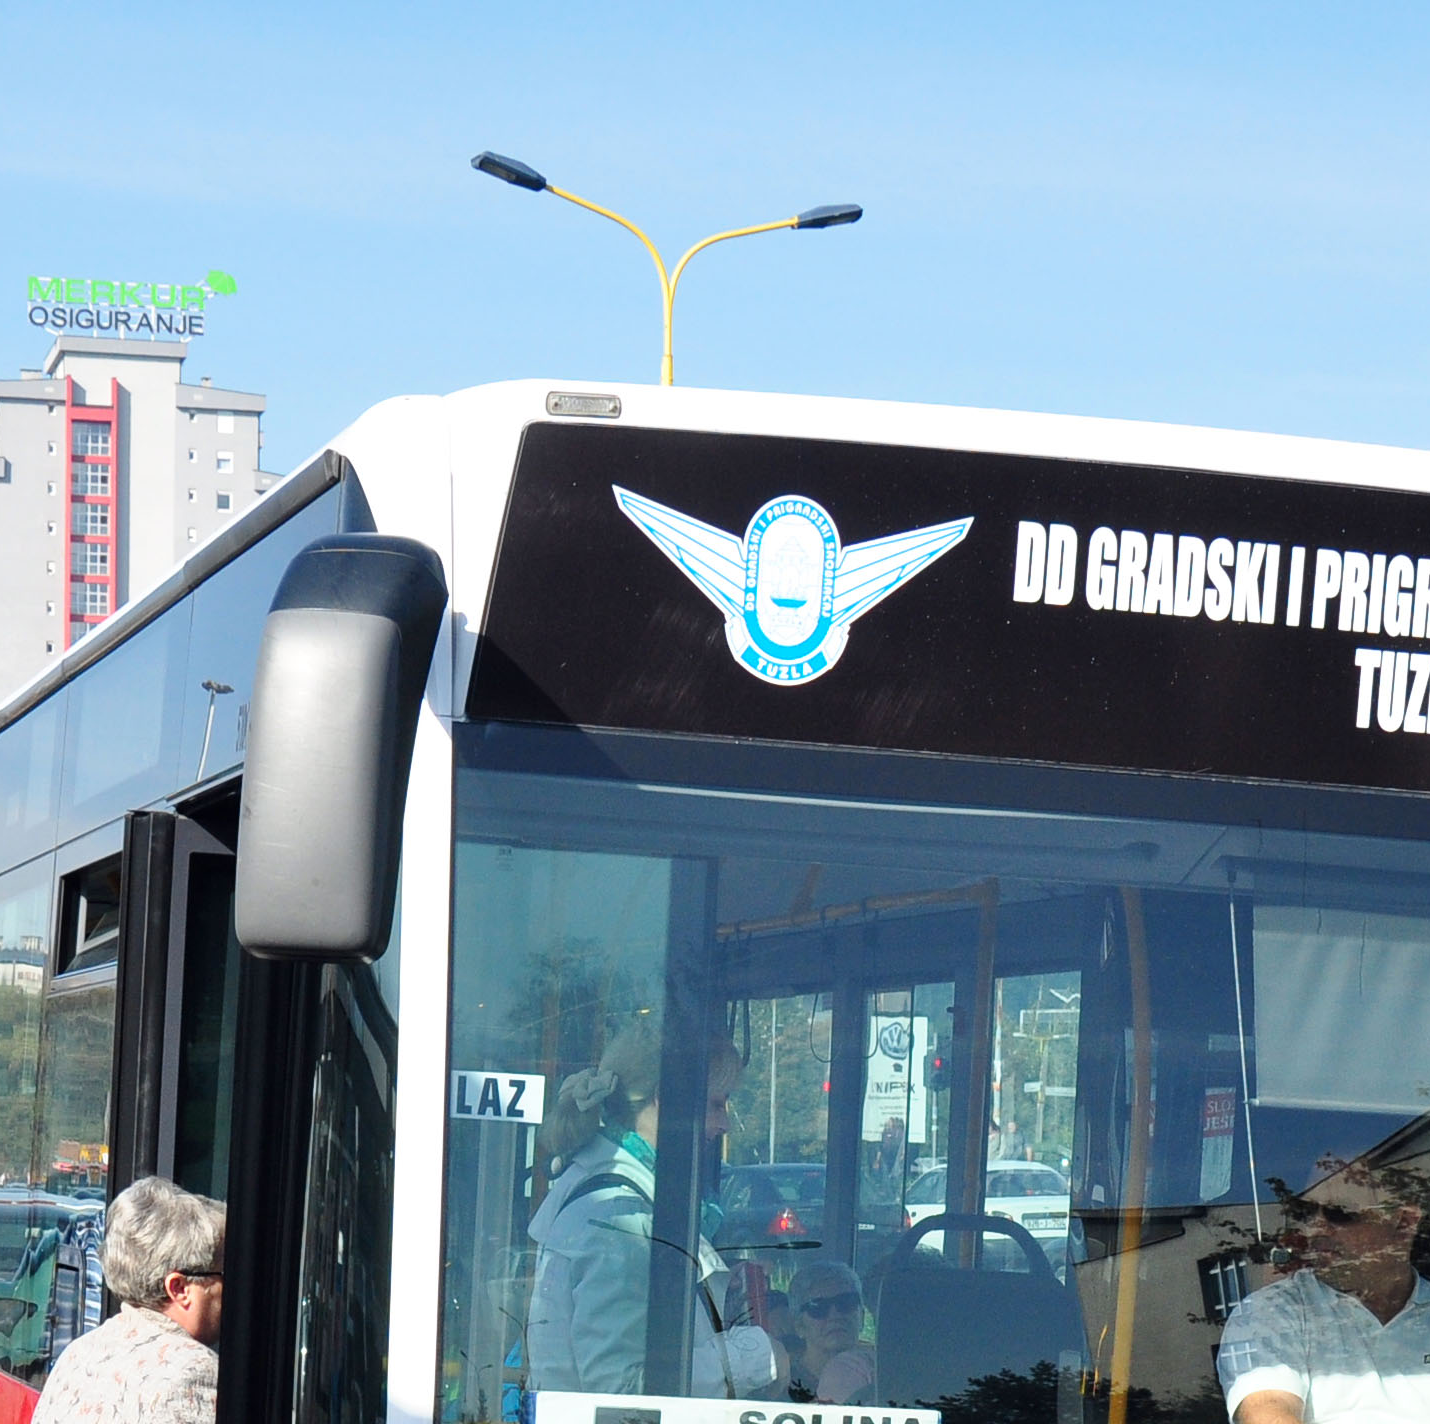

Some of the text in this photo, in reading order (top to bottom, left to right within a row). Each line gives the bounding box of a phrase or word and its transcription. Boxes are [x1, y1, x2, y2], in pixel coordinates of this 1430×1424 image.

[28, 276, 205, 310] MERKUR
[28, 305, 204, 336] OSIGURANJE
[1013, 521, 1078, 606] DD
[1085, 527, 1281, 625] GRADSKI
[1285, 546, 1306, 627] I
[757, 658, 812, 679] TUZLA
[456, 1075, 526, 1118] LAZ
